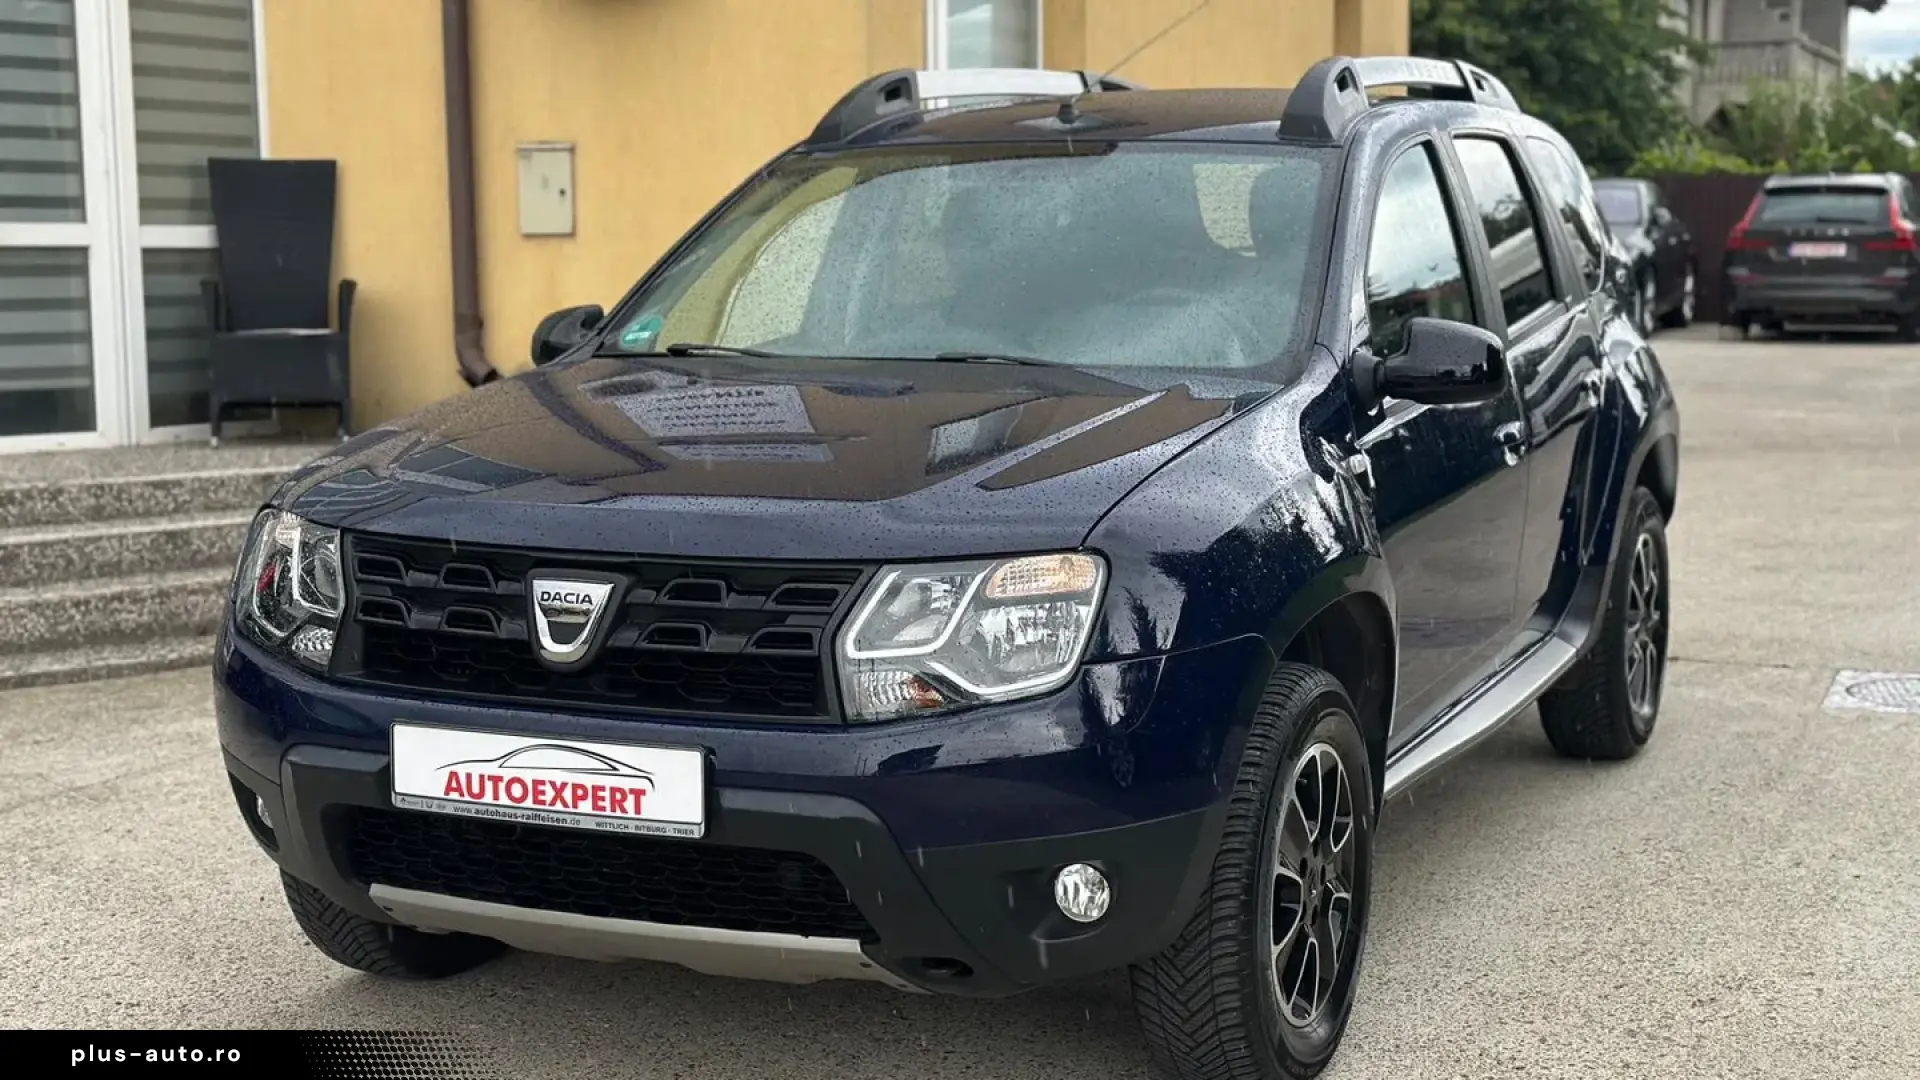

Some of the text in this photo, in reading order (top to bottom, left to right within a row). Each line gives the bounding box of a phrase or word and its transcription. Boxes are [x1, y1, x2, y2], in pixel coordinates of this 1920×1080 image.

[540, 591, 593, 605] DACIA
[443, 770, 647, 816] AUTOEXPERT
[453, 805, 581, 826] www.autohaus-raiffeisen.de
[595, 821, 695, 836] WITTLICH BITBURG TRIER
